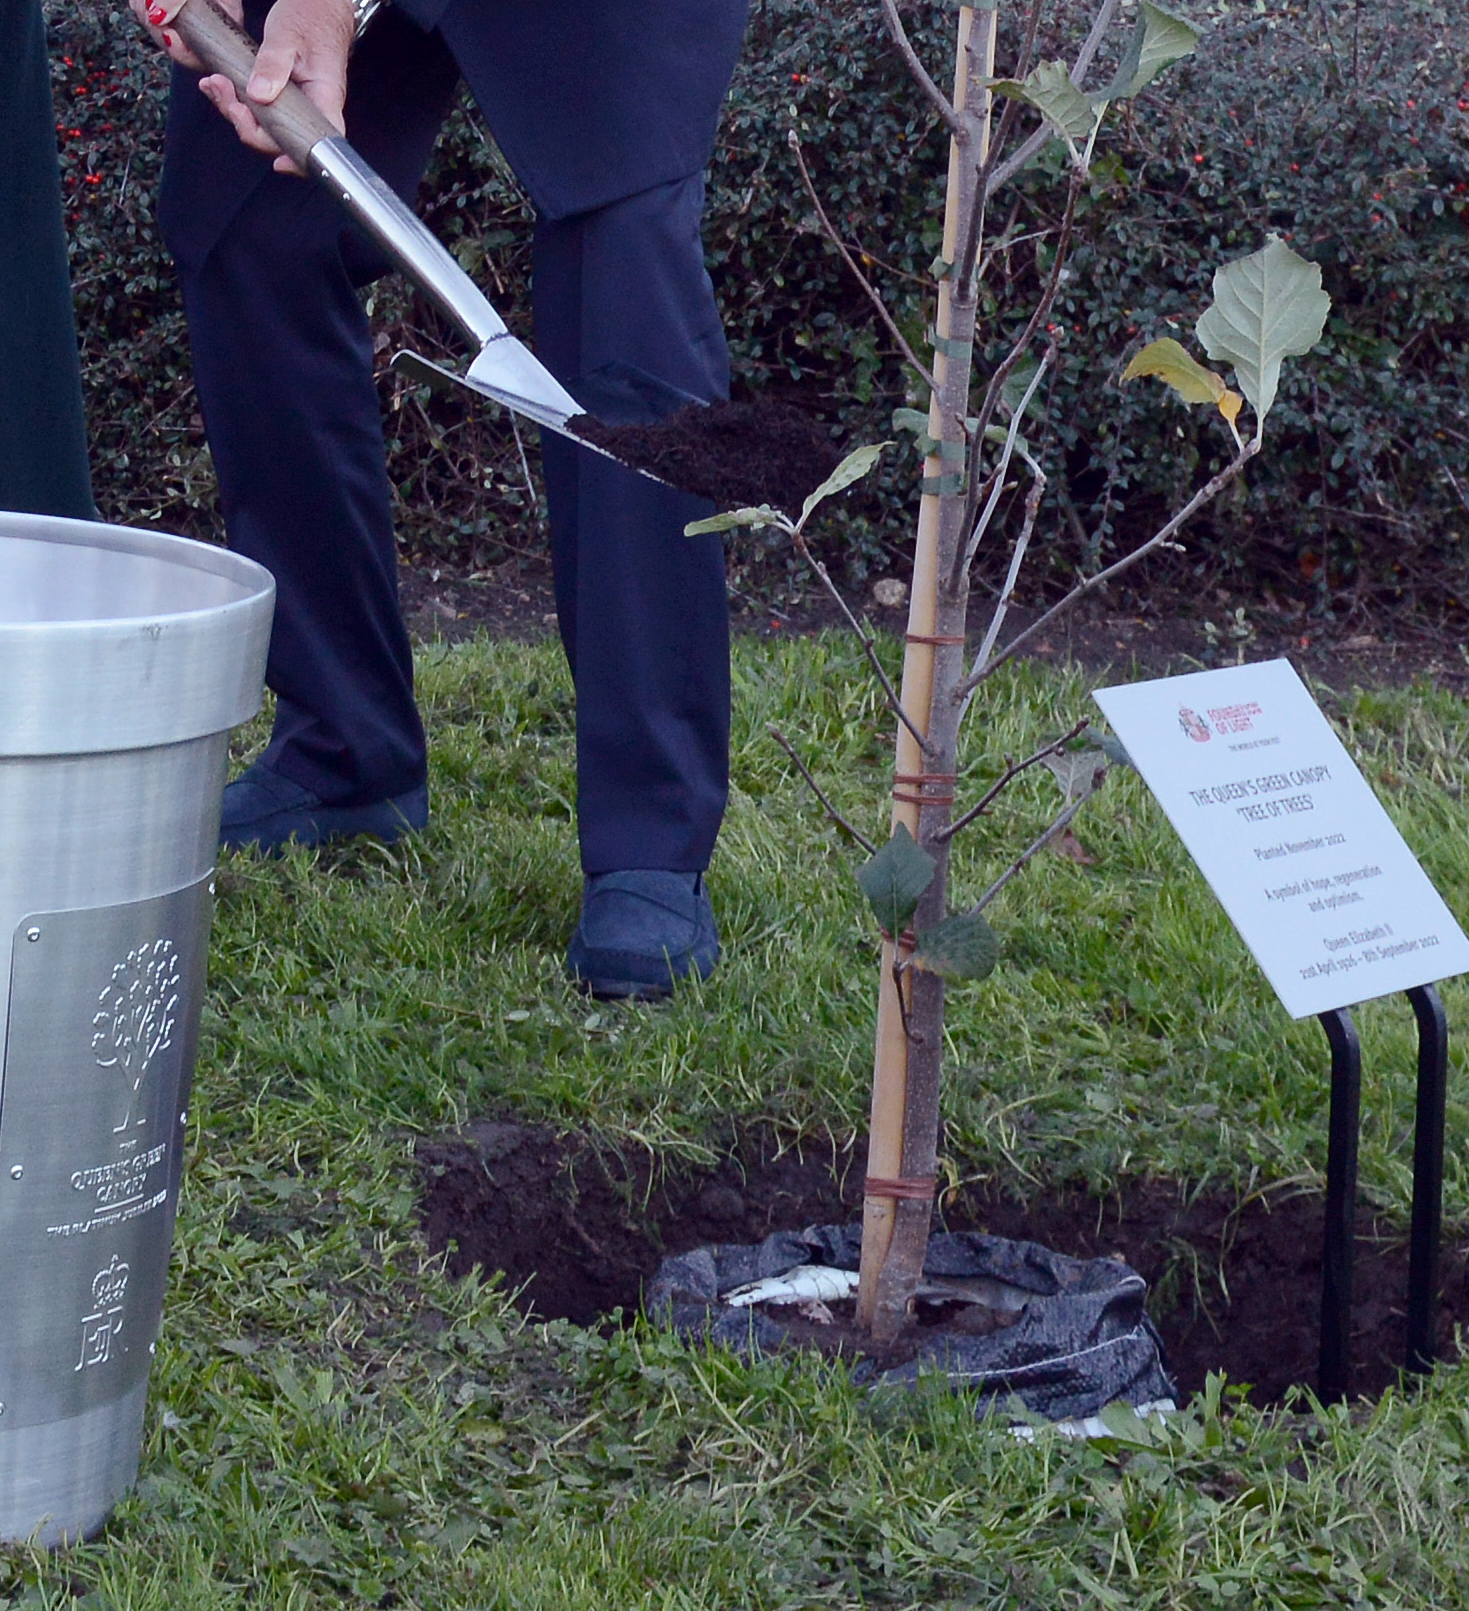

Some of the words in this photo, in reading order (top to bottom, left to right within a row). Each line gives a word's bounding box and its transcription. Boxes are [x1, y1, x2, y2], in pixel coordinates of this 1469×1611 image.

[1188, 787, 1214, 807] THE
[1211, 779, 1258, 804] QUEEN'S
[1256, 772, 1292, 794] GREEN
[1289, 764, 1332, 786] CANOPY
[1265, 800, 1282, 817] OF
[1254, 843, 1287, 861] Planted
[1285, 837, 1325, 854] November
[1325, 833, 1346, 846] 2022
[1264, 888, 1274, 901] A
[1272, 881, 1301, 902] symbol
[1301, 878, 1310, 892] of
[1333, 864, 1383, 886] regeneration
[1308, 897, 1325, 912] and
[1323, 937, 1352, 952] Queen
[1348, 925, 1387, 944] Elizabeth
[1299, 963, 1318, 980] 21st
[1315, 958, 1337, 977] April
[1336, 953, 1358, 972] 1926
[1362, 948, 1379, 963] 8th
[1376, 939, 1420, 960] September
[1418, 934, 1440, 949] 2022
